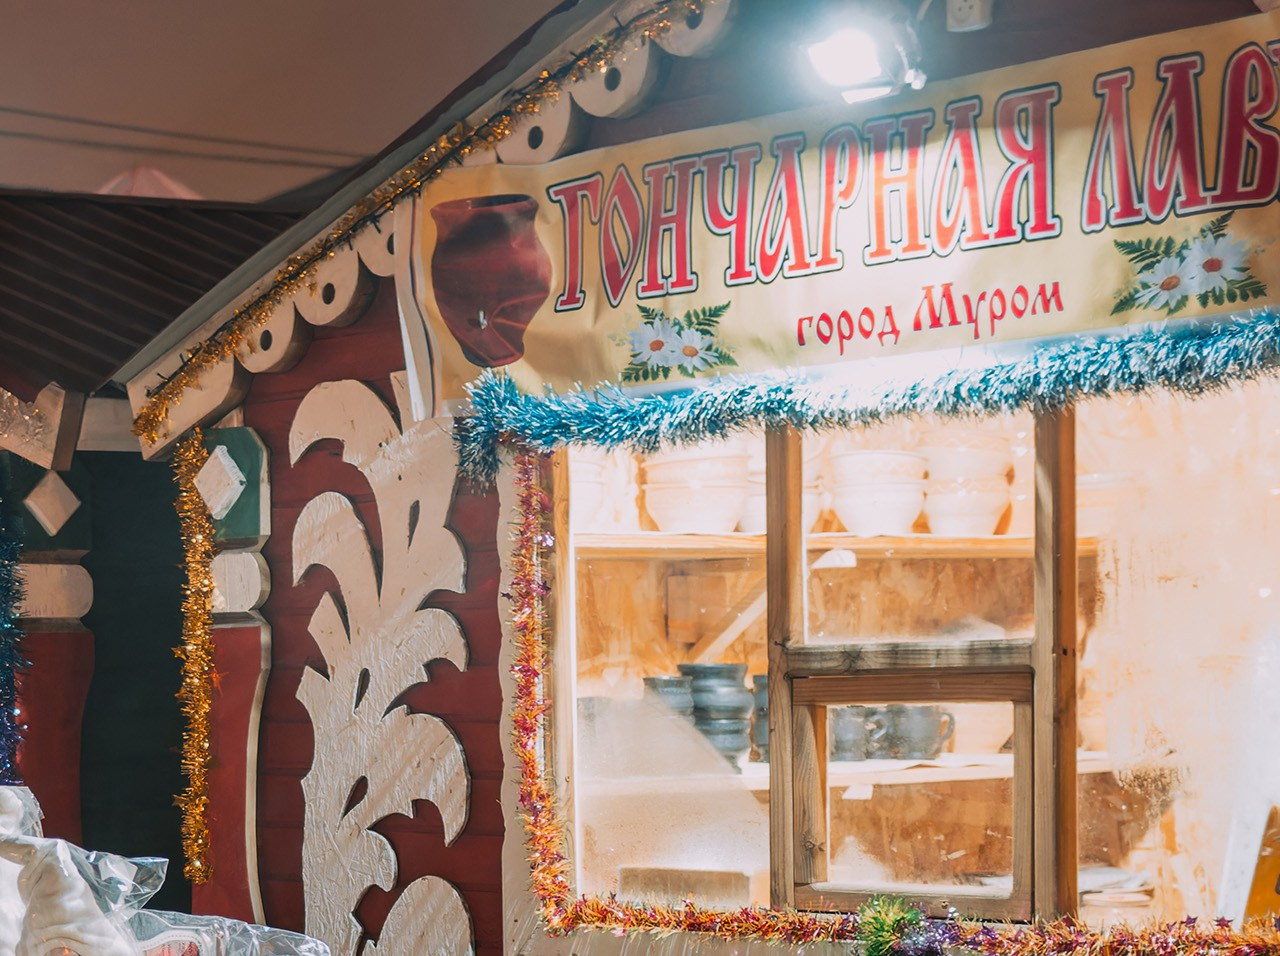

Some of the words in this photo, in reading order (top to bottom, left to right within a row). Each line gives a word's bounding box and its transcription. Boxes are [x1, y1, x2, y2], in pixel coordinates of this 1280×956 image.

[547, 82, 1062, 312] ГОНЧАРНАЯ
[1080, 40, 1280, 234] ЛАВ
[797, 305, 901, 356] город
[913, 281, 1064, 340] Муром
